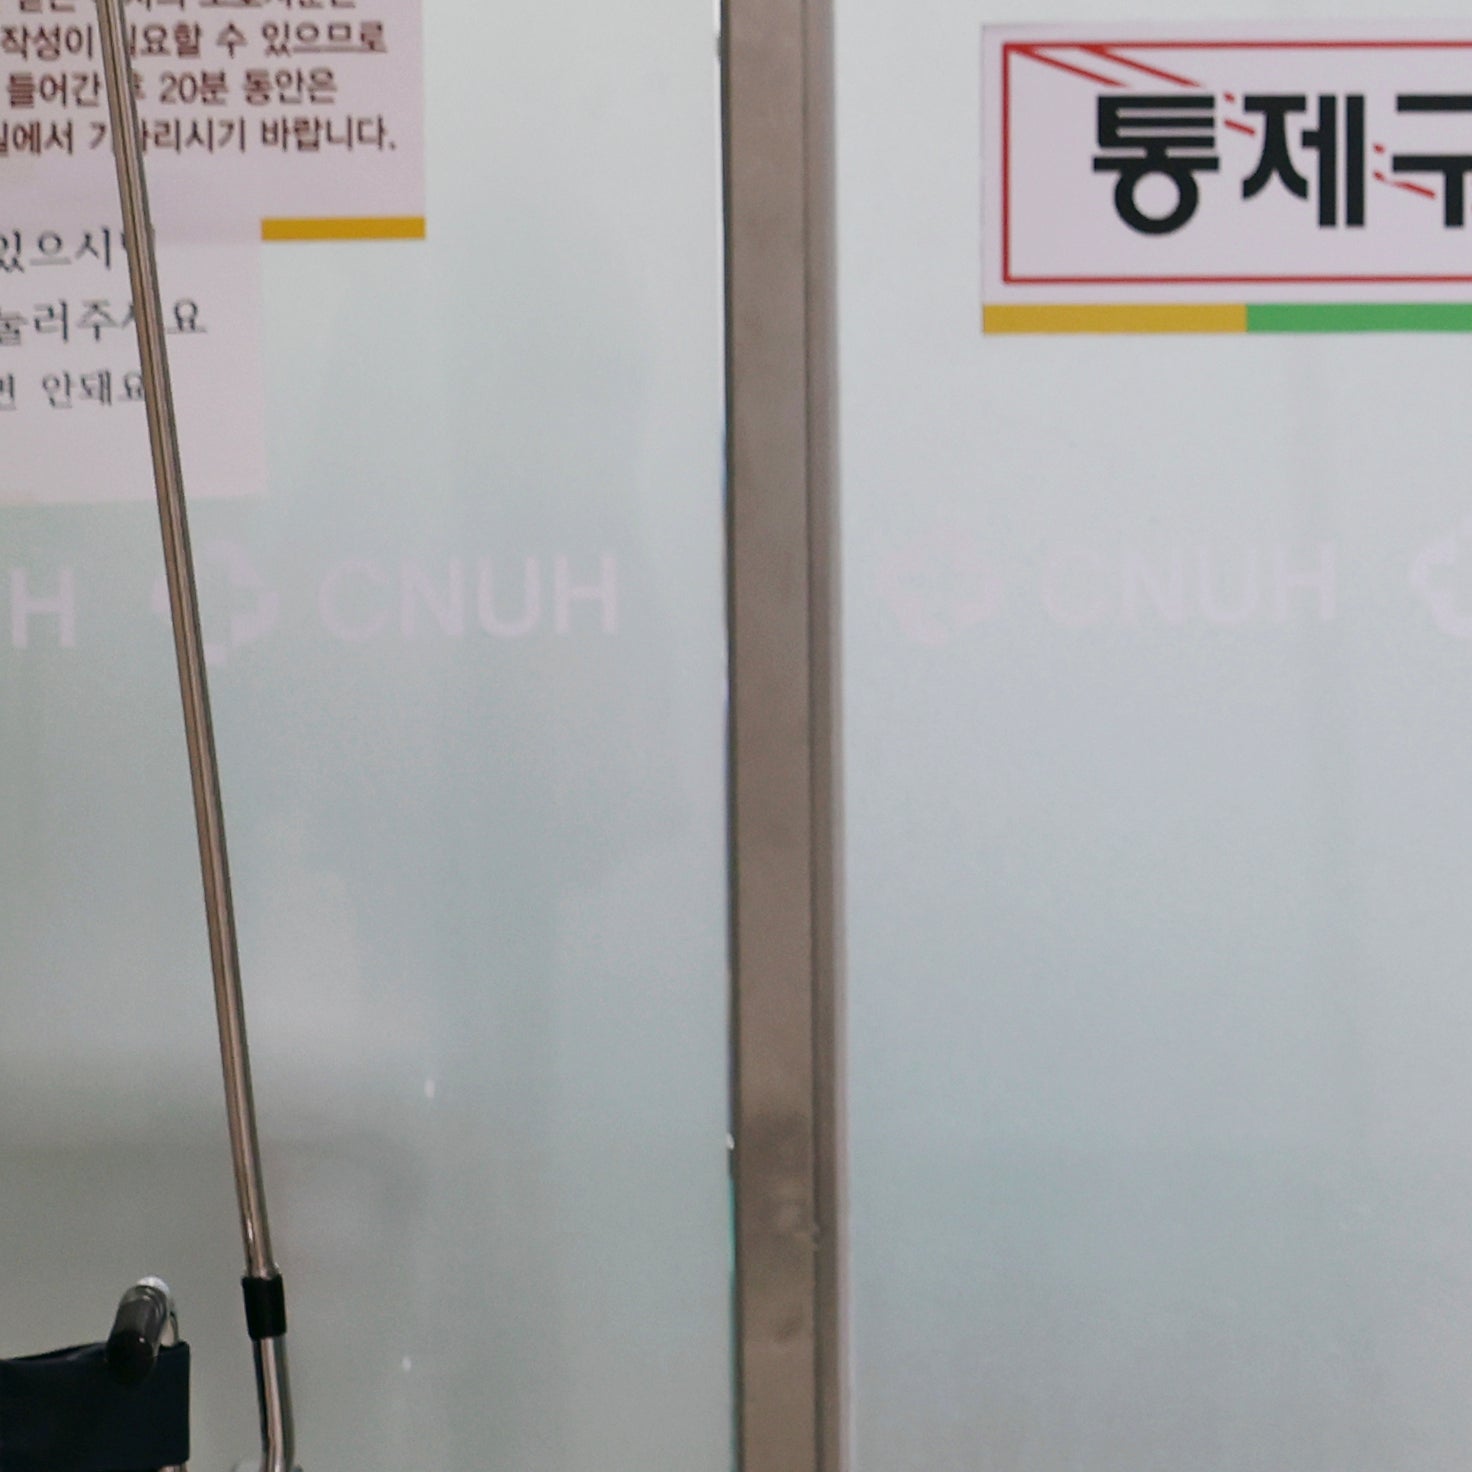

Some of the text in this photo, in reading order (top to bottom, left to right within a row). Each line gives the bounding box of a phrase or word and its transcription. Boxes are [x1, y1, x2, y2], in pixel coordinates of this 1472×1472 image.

[216, 22, 249, 59] 수
[262, 20, 388, 58] 있으므로
[7, 71, 102, 109] 들어간
[160, 69, 229, 107] 20분
[243, 66, 338, 108] 동안은
[261, 114, 397, 153] 바랍니다.
[318, 554, 619, 643] CNUH
